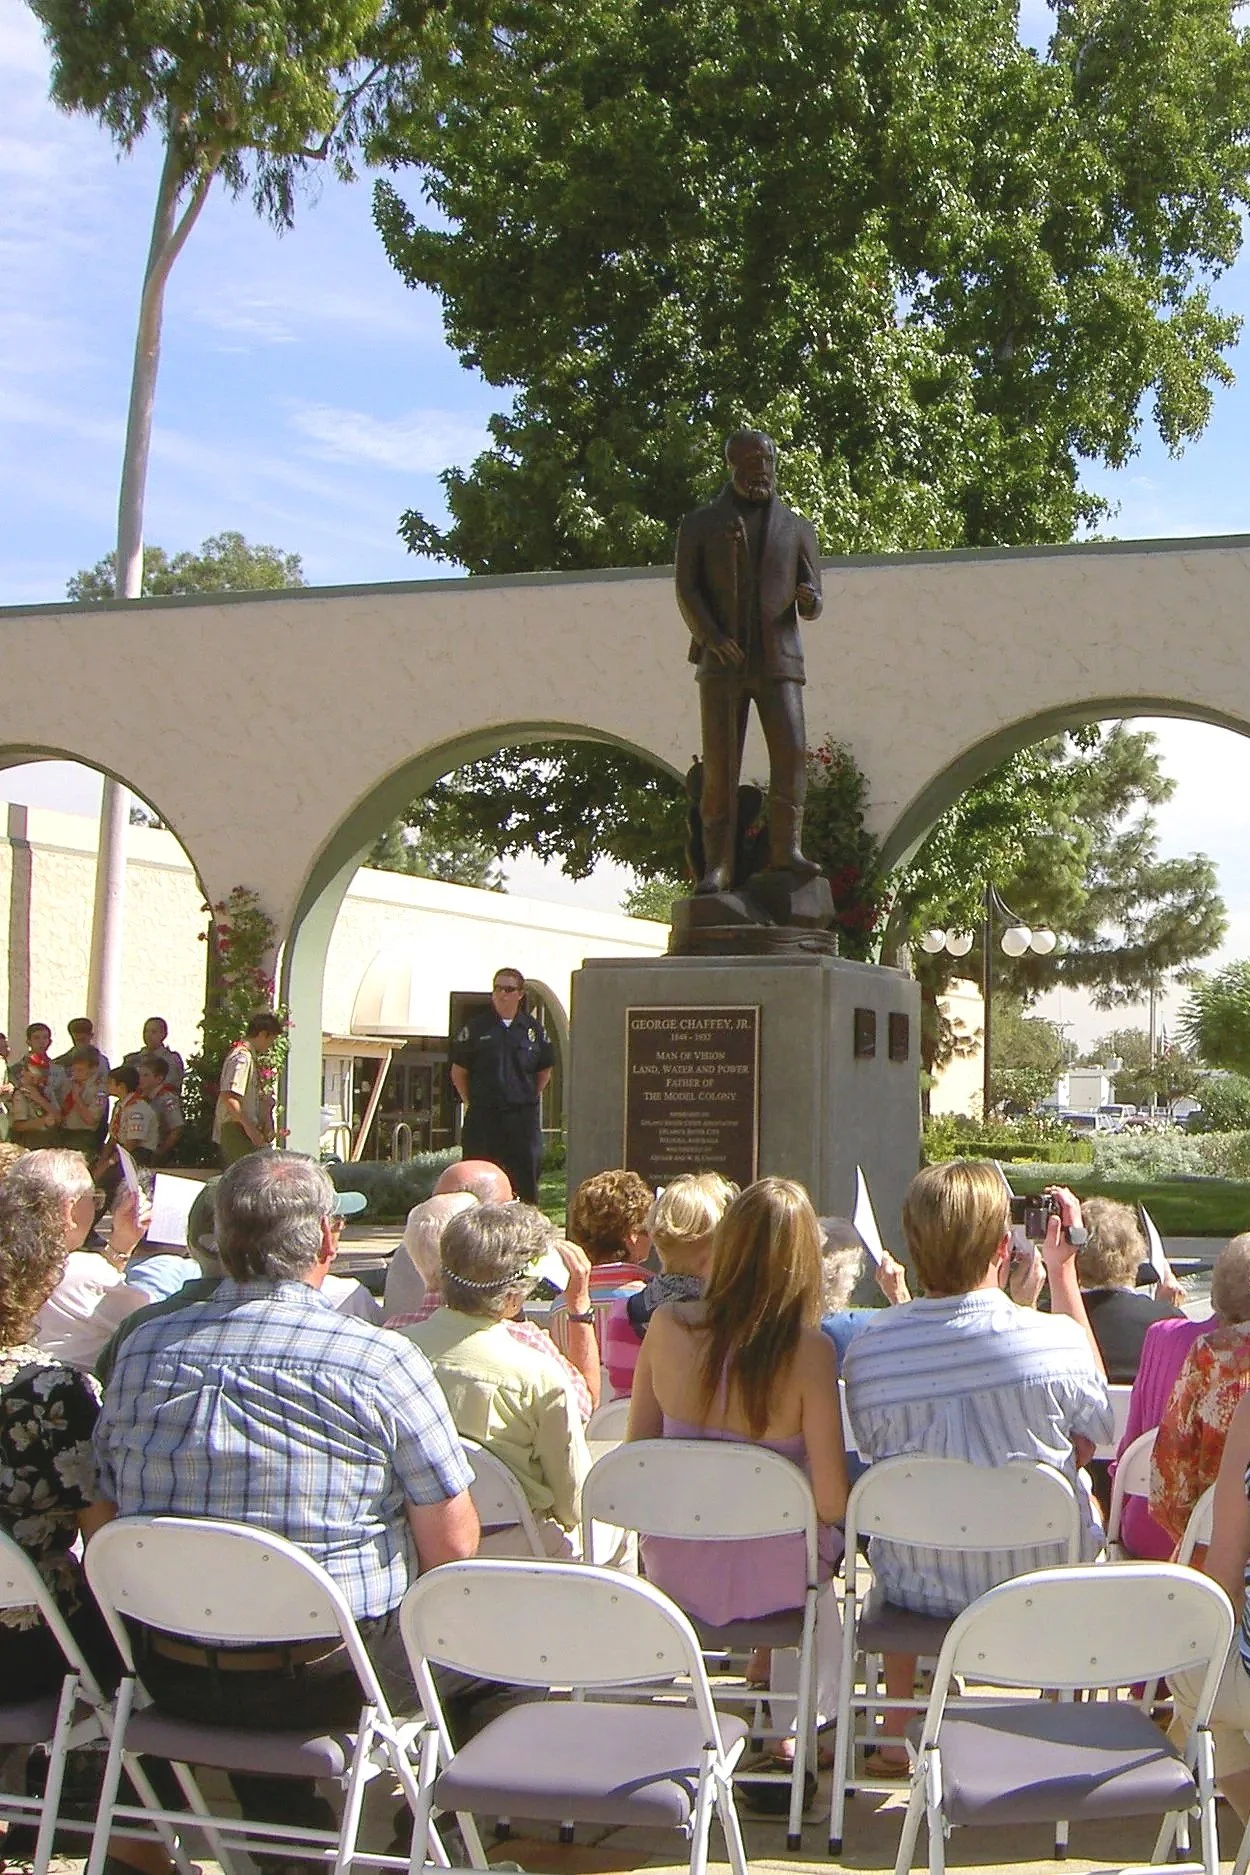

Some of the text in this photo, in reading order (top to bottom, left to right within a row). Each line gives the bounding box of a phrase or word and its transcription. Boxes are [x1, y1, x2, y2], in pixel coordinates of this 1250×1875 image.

[631, 1018, 752, 1030] GEORGE CHAFFEY, JR.
[656, 1051, 726, 1060] MAN OF VISION
[632, 1065, 749, 1074] LAND, WATER AND POWER
[666, 1078, 714, 1087] FATHER OF
[644, 1092, 737, 1101] THE MODEL COLONY
